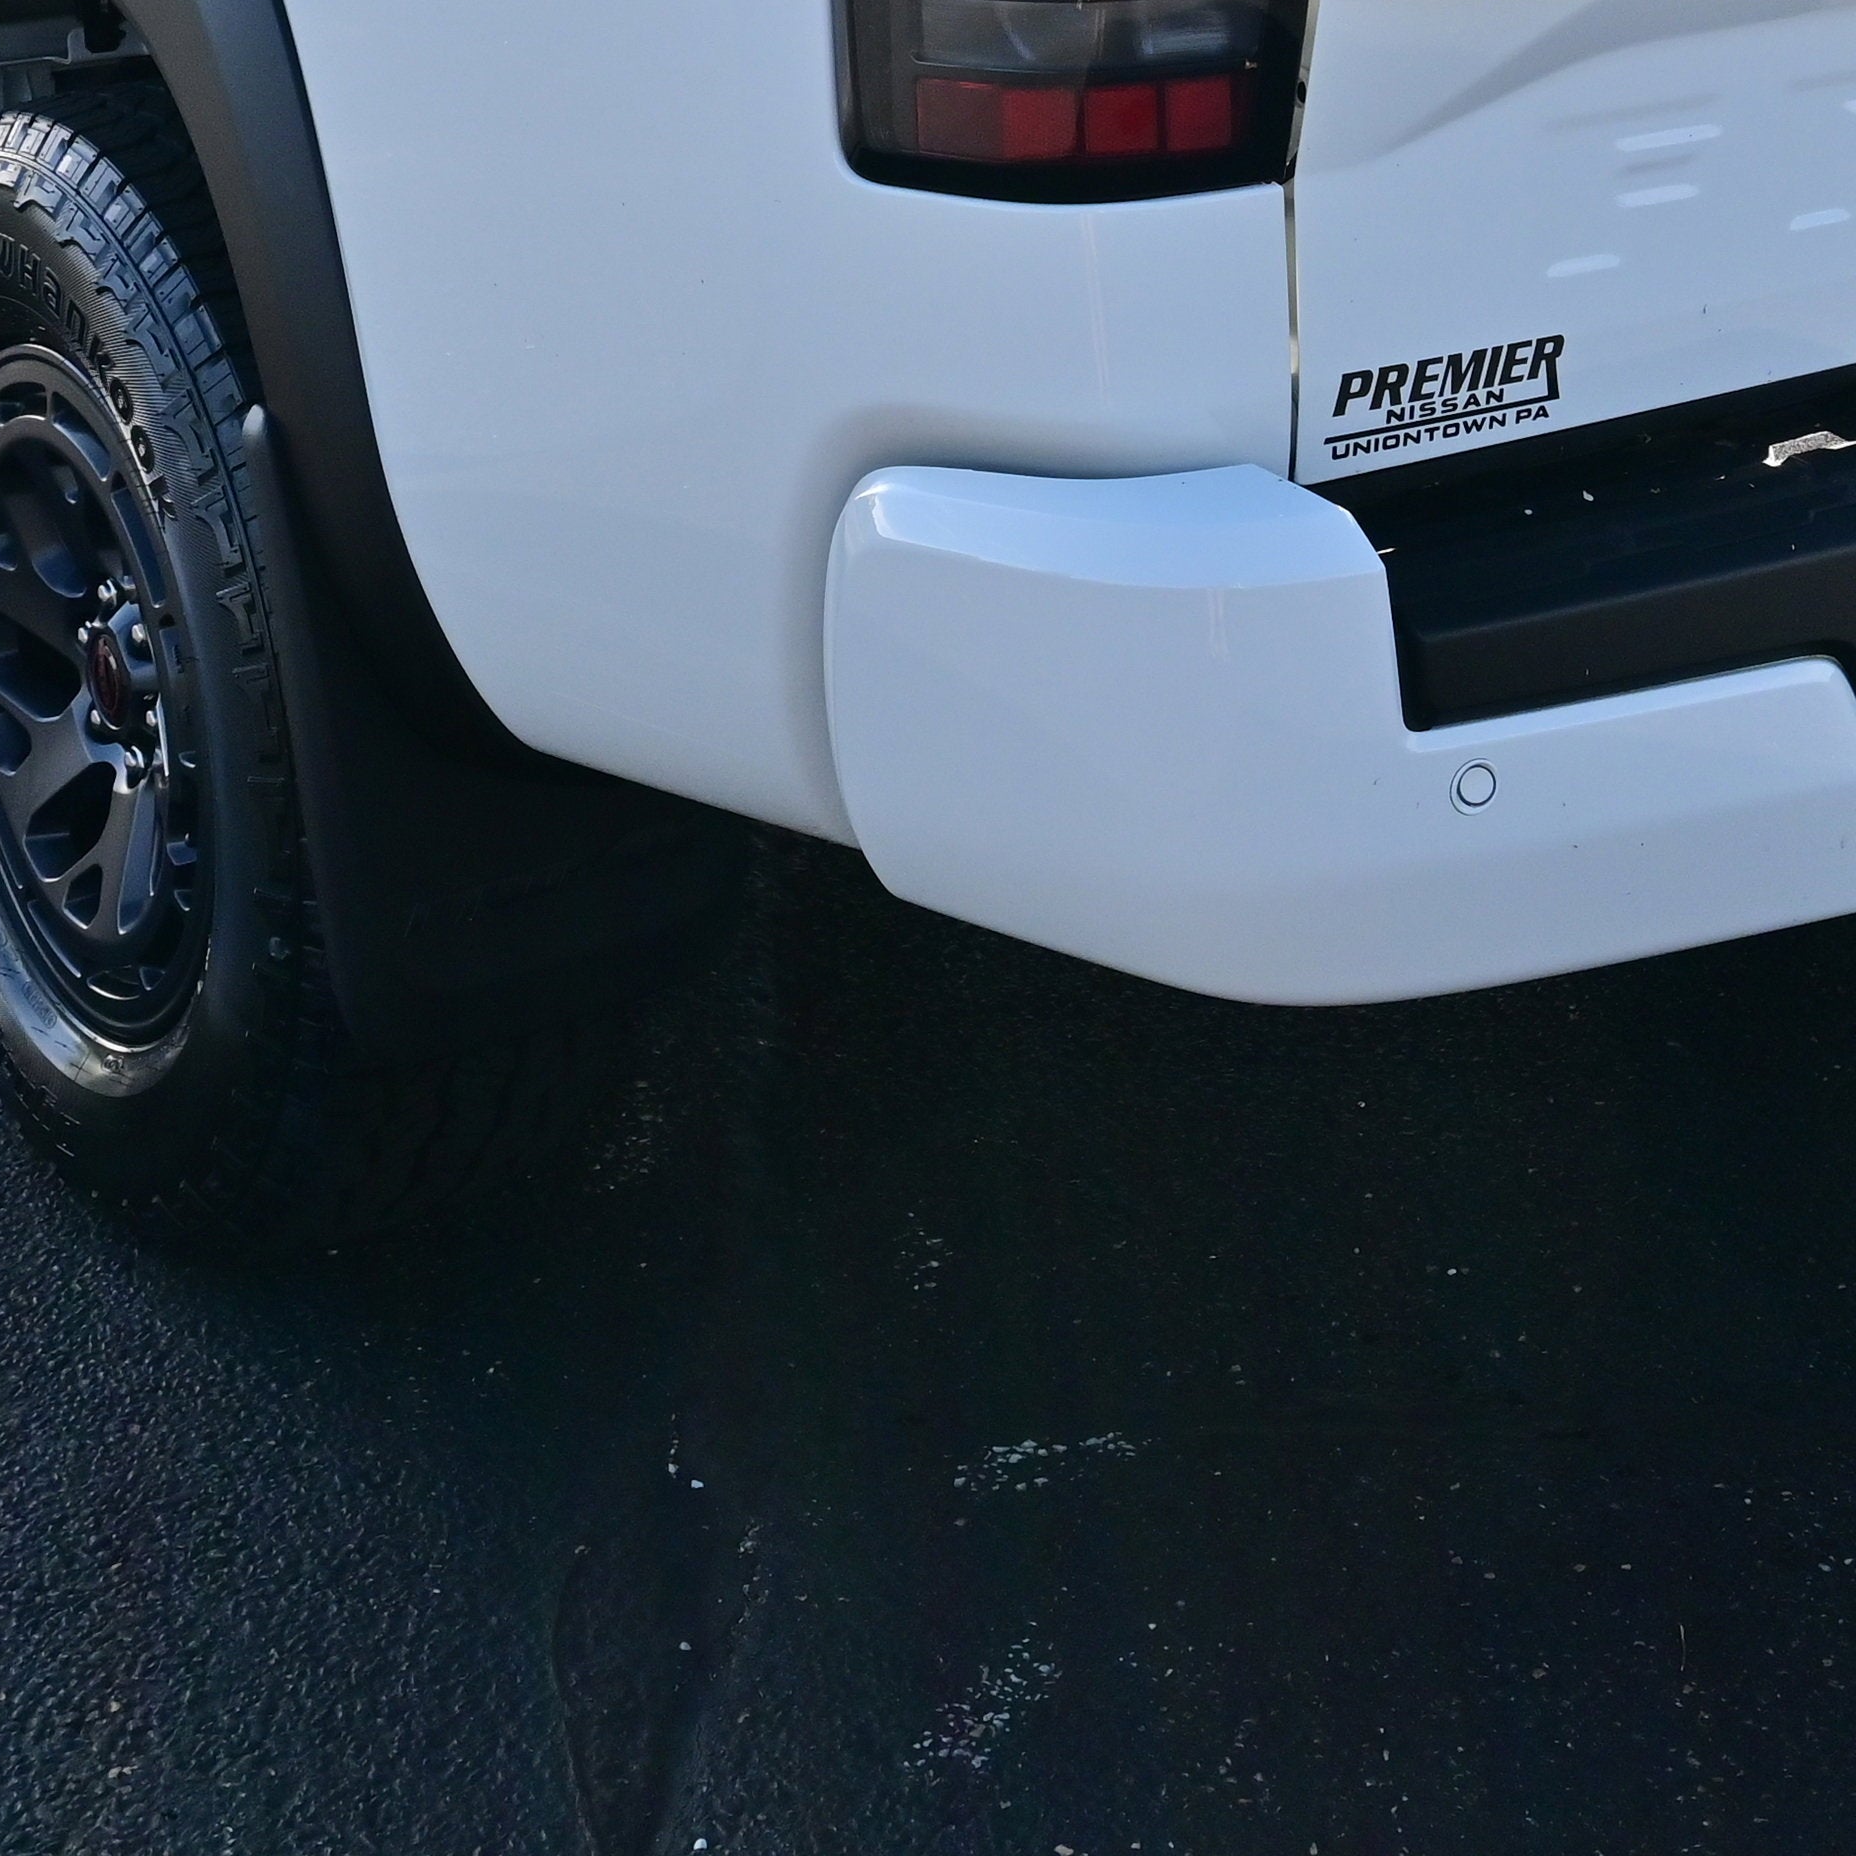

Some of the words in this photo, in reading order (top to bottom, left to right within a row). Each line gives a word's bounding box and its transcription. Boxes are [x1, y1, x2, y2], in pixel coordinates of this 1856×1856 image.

[17, 242, 180, 522] Hankook
[1332, 333, 1565, 418] PREMIER
[1385, 388, 1505, 425] NISSAN
[1331, 412, 1507, 461] UNIONTOWN
[1515, 405, 1550, 425] PA
